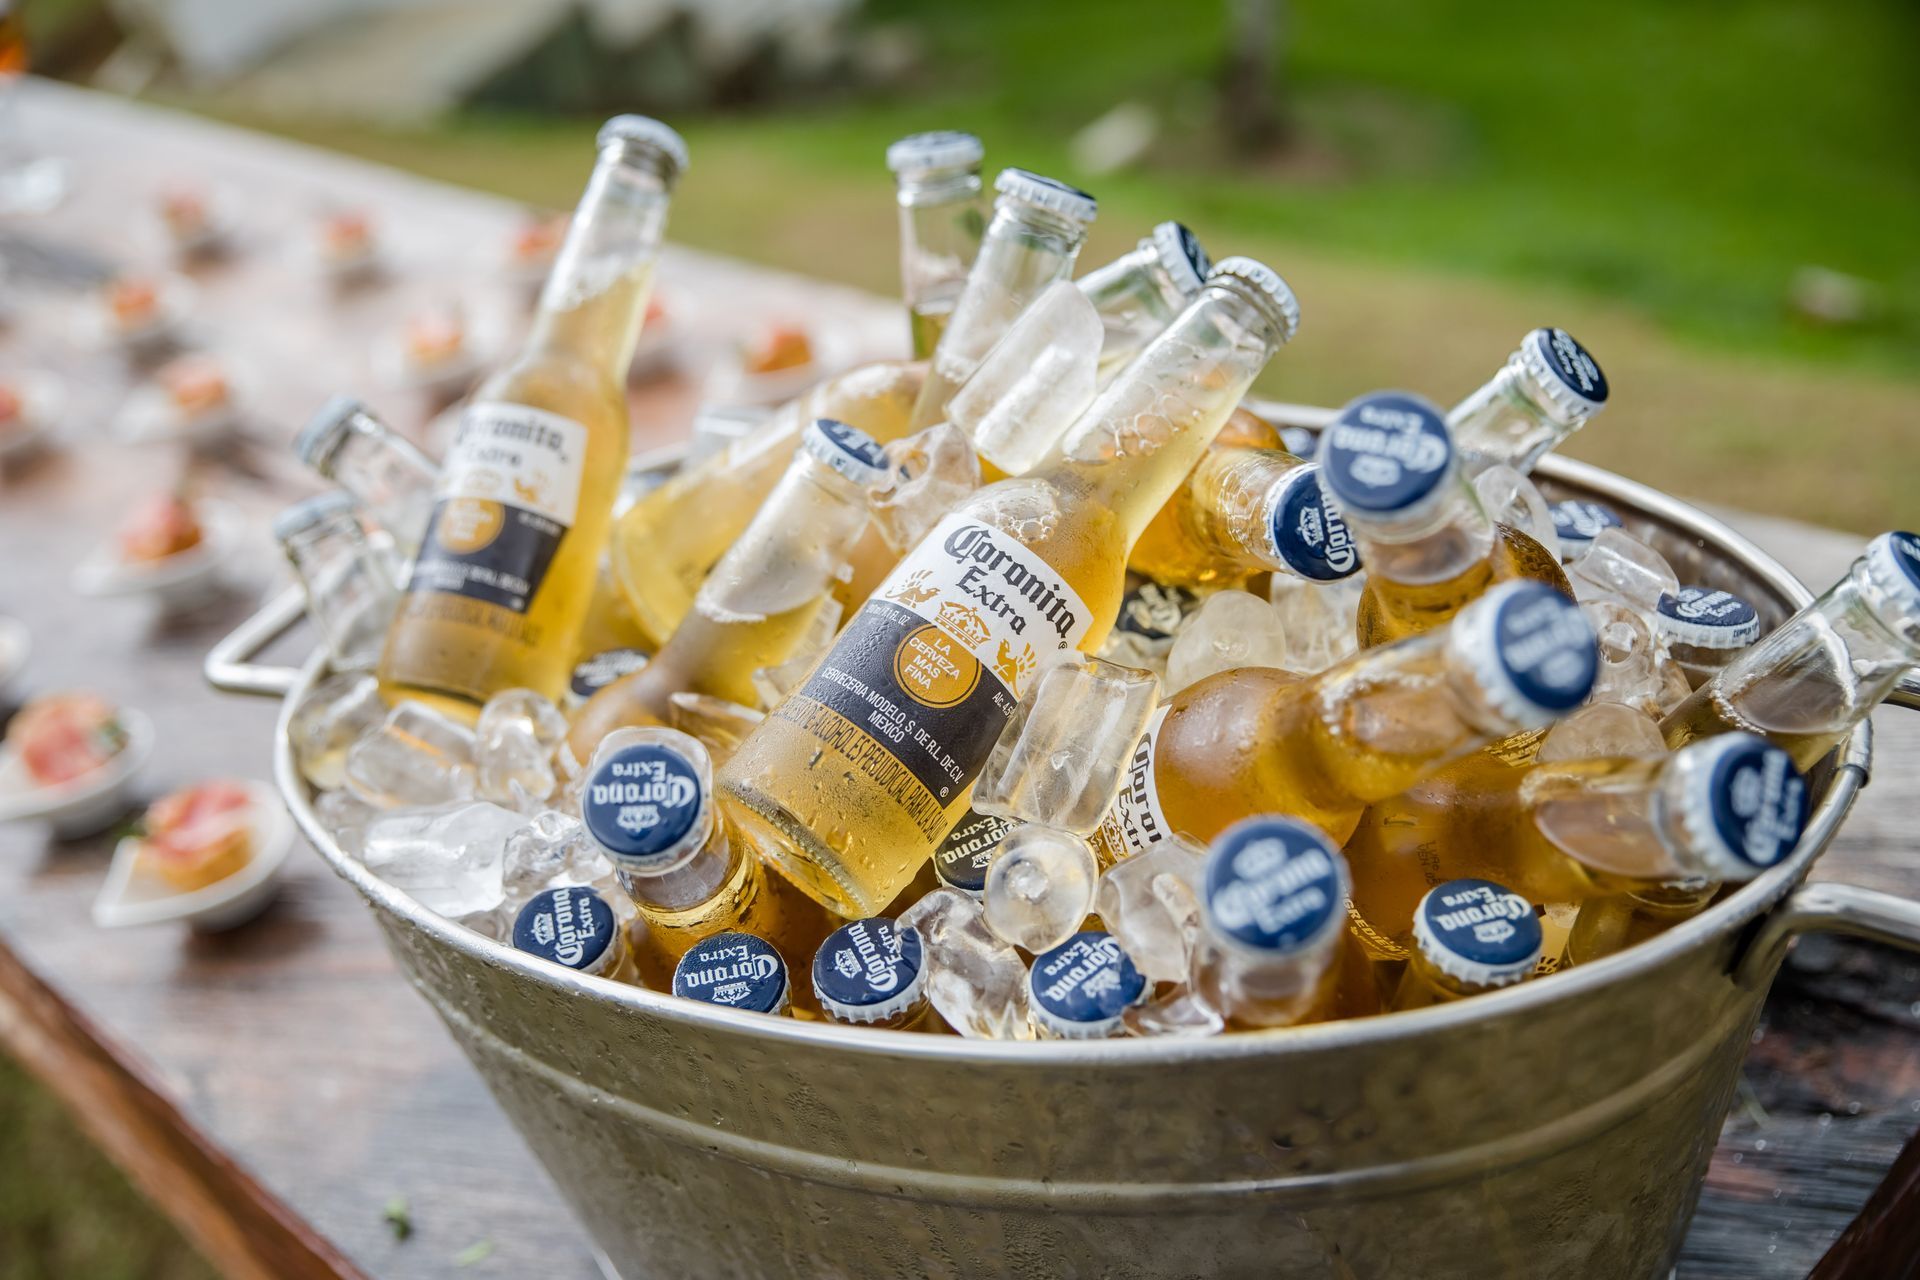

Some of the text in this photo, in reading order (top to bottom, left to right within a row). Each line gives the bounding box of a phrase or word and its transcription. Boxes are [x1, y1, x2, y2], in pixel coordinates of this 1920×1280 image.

[944, 525, 1076, 639] Coronita
[956, 565, 1026, 635] Extra
[908, 637, 960, 680] CERVEZA
[933, 638, 951, 656] LA
[904, 664, 932, 689] FINA
[913, 655, 940, 678] MAS
[822, 667, 869, 698] CERVECERIA
[914, 728, 930, 747] DE
[940, 753, 954, 774] DE
[868, 711, 905, 743] MEXICO
[846, 735, 870, 762] ES
[612, 761, 666, 782] Extra
[856, 742, 915, 804] PERJUDICIAL
[593, 775, 697, 808] Corona
[900, 784, 931, 821] PARA
[951, 817, 998, 841] Extra
[1437, 893, 1532, 931] Corona
[1441, 886, 1490, 908] Extra
[553, 887, 584, 966] Corona
[576, 897, 596, 940] Extra
[686, 953, 778, 988] Corona
[700, 945, 750, 962] Extra
[848, 923, 899, 992] Corona
[1044, 941, 1092, 977] Extra
[1049, 936, 1121, 1002] Corona
